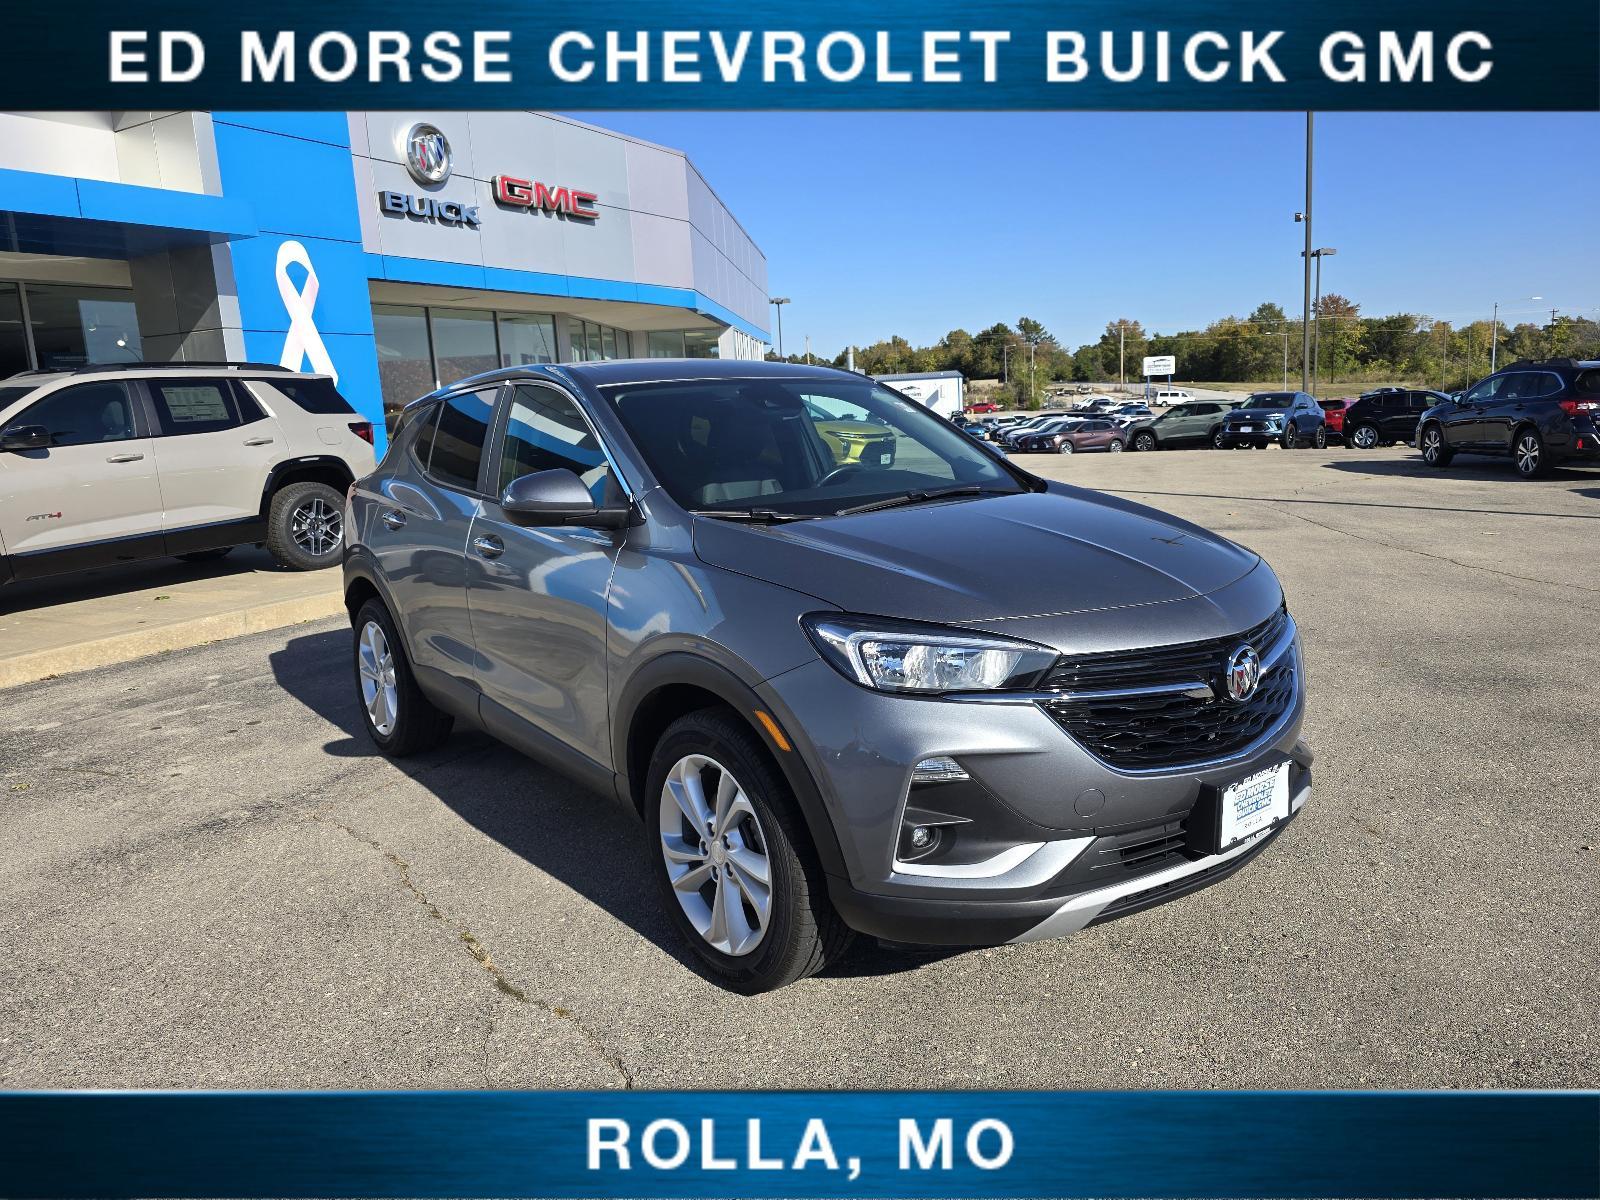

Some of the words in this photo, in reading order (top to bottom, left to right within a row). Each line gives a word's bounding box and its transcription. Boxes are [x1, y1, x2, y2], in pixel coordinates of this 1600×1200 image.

[380, 191, 482, 228] BUICK
[493, 175, 600, 219] GMC
[1246, 778, 1276, 799] MORSE
